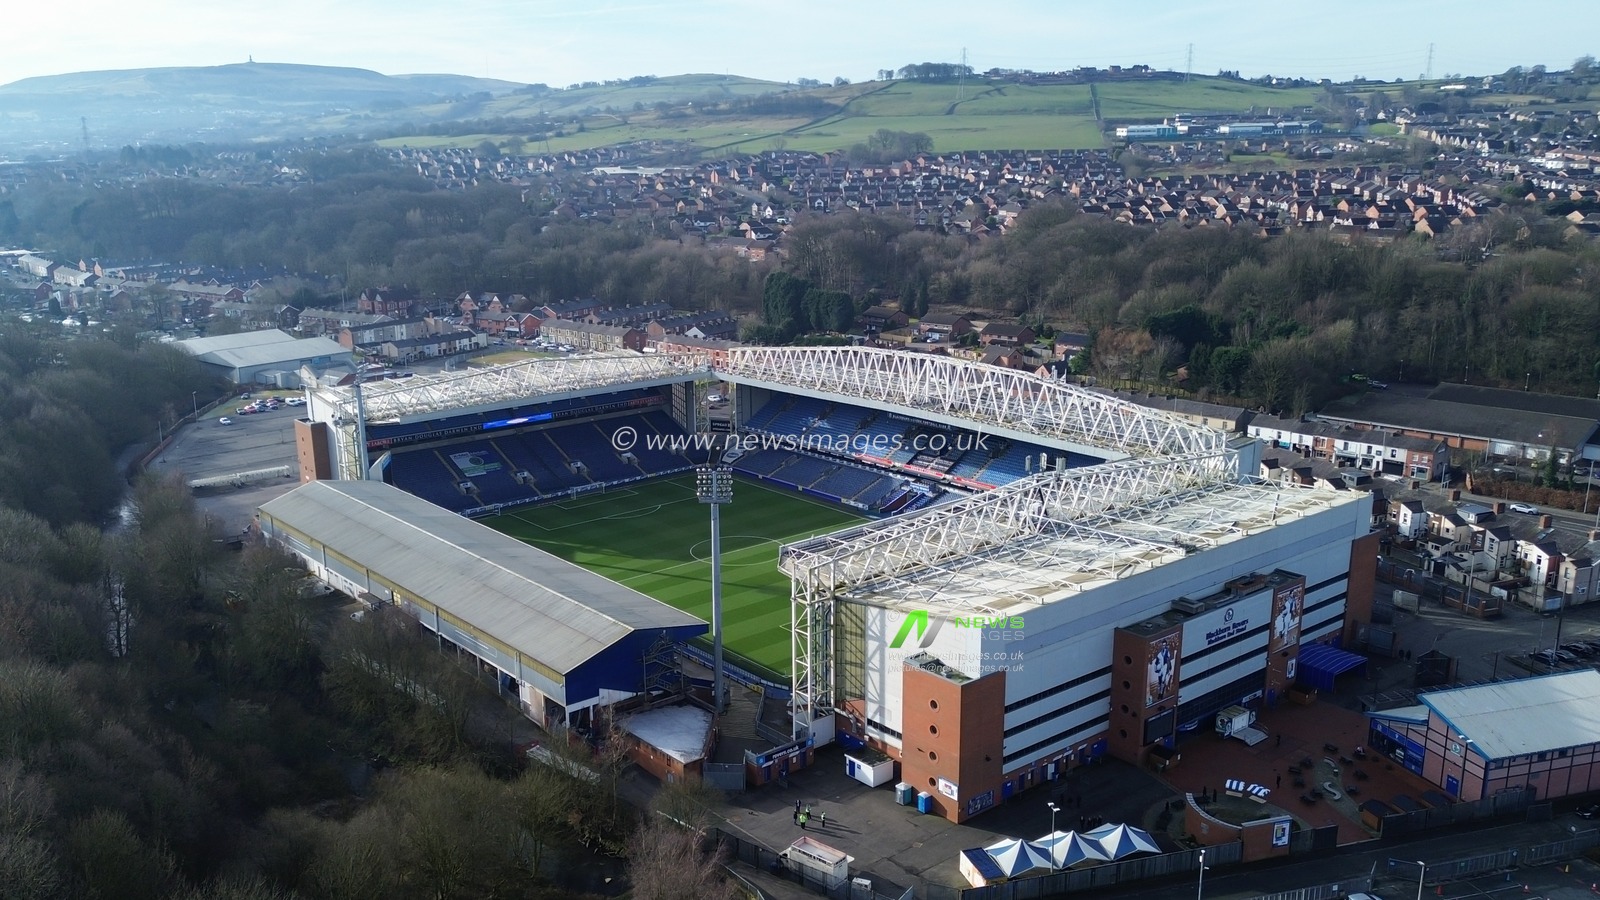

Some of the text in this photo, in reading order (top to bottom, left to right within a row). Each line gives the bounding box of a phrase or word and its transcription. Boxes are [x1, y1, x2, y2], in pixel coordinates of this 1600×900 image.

[1206, 619, 1248, 640] Blackburn Rovers
[772, 745, 799, 759] rovers.co.uk
